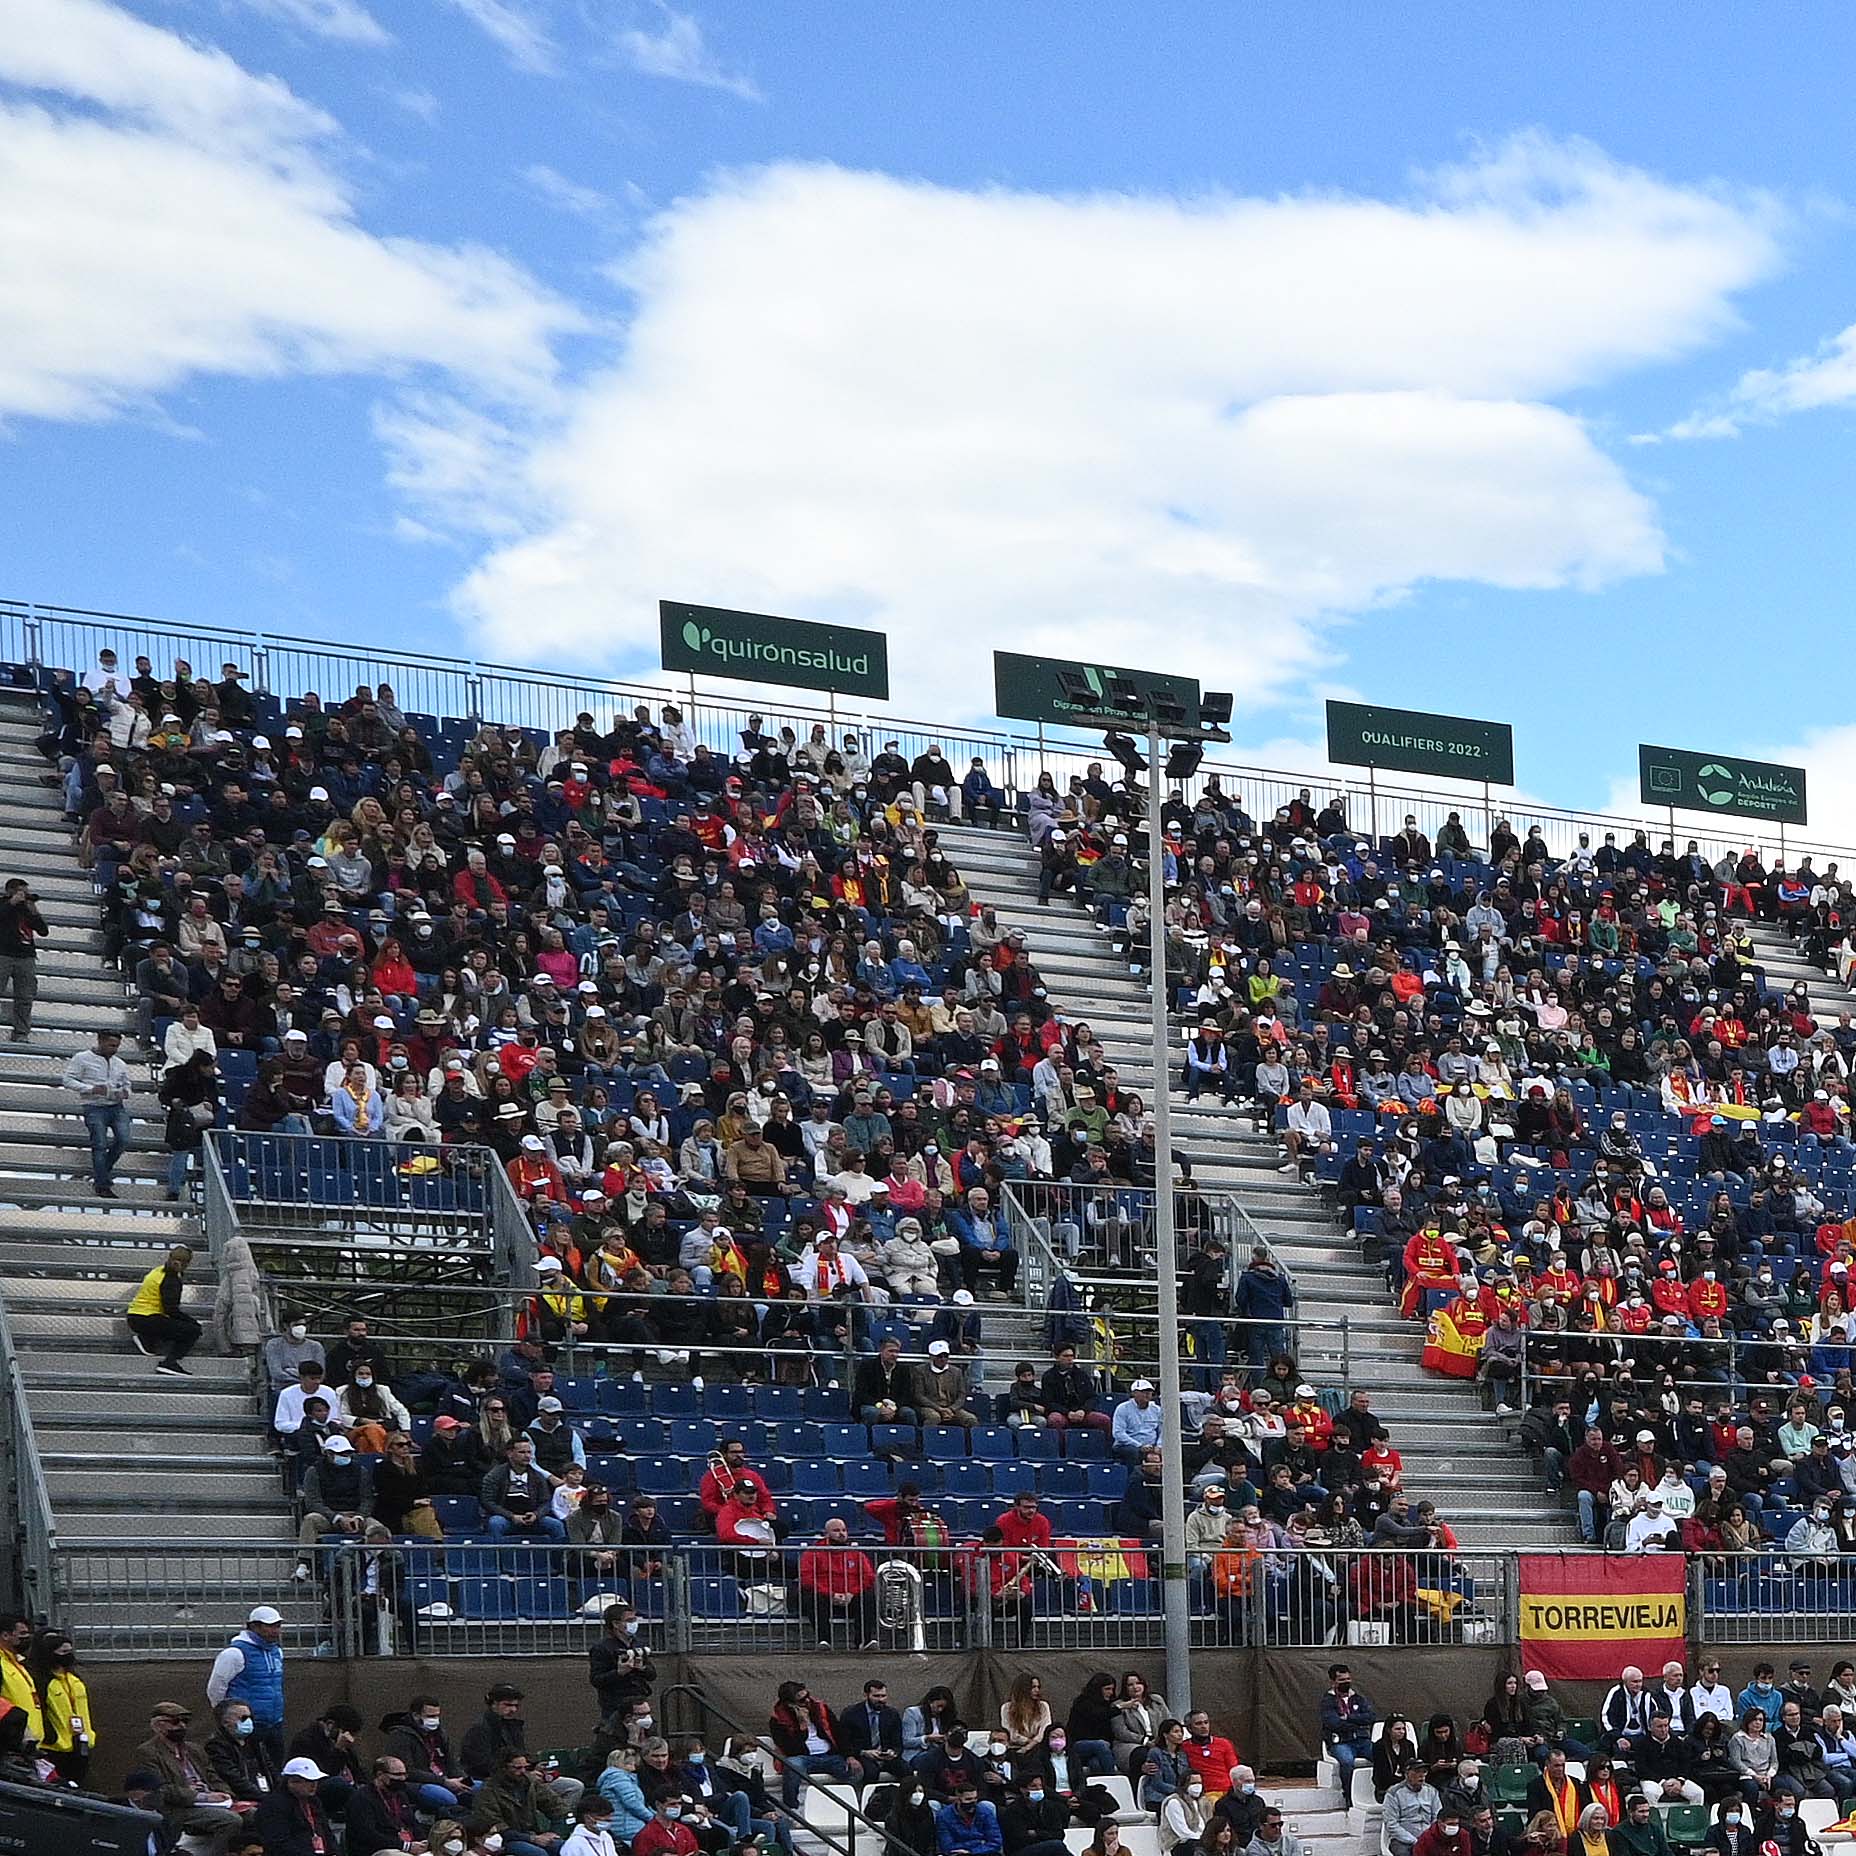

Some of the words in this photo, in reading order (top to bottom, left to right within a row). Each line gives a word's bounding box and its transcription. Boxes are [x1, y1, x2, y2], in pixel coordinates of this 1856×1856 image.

[711, 638, 869, 676] quirónsalud
[1361, 731, 1444, 752] QUALIFIERS
[1448, 743, 1481, 757] 2022
[1737, 798, 1777, 810] DEPORTE
[1529, 1604, 1679, 1630] TORREVIEJA
